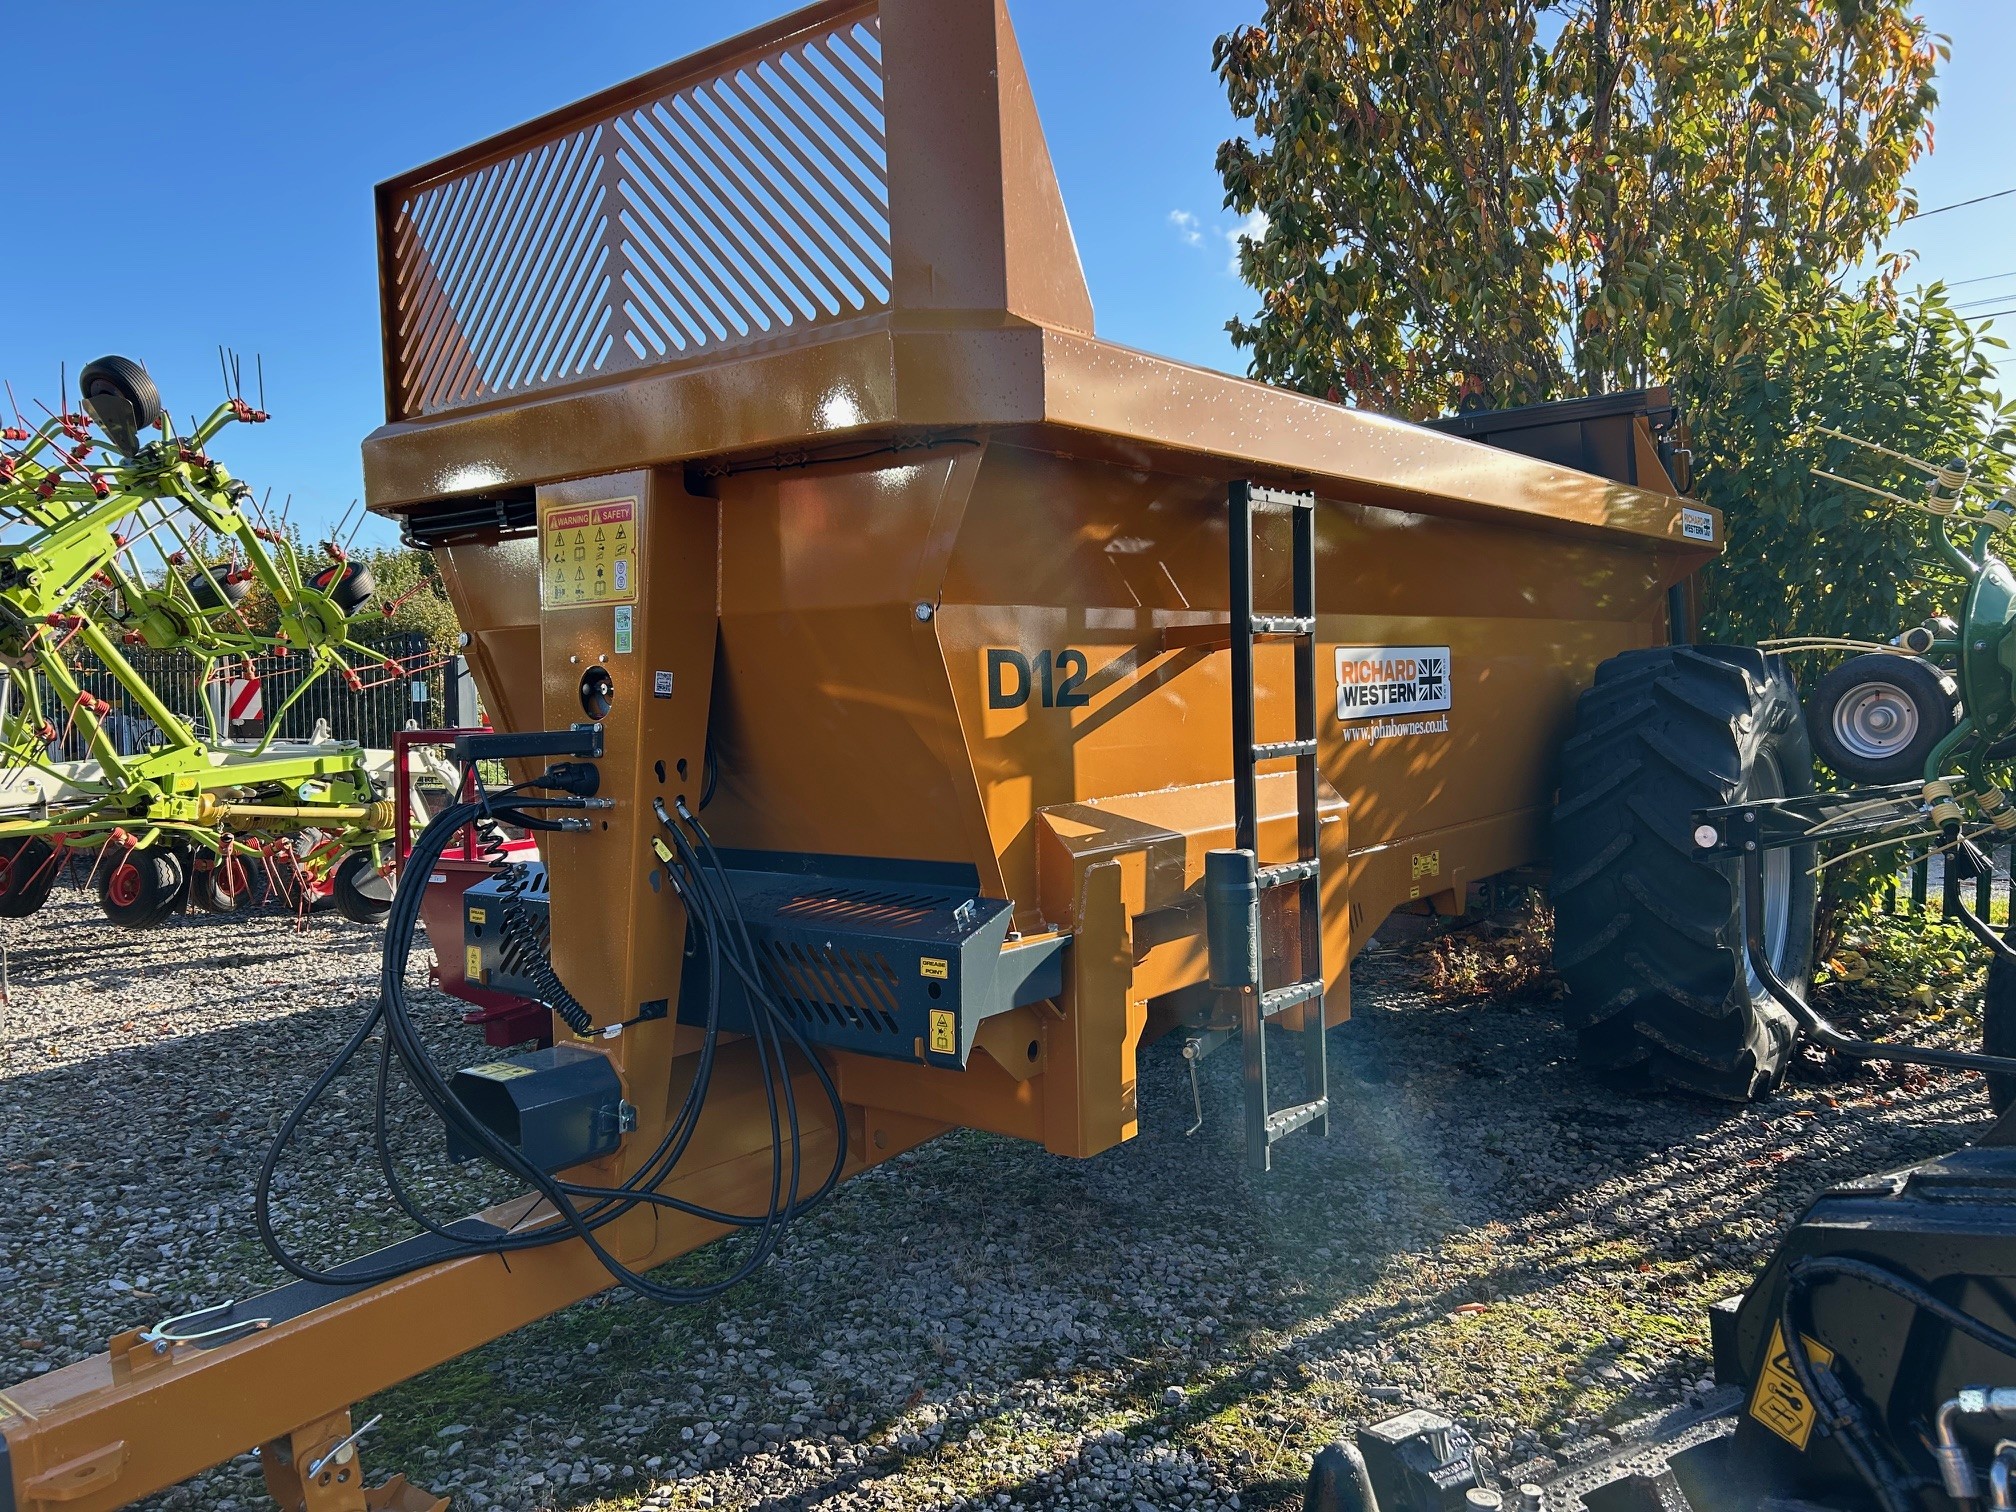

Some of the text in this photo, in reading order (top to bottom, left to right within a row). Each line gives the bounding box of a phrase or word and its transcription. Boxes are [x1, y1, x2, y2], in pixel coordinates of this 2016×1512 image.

[558, 509, 630, 526] WARNING SAFETY
[987, 649, 1090, 709] D12
[1341, 659, 1417, 684] RICHARD
[1343, 683, 1417, 707] WESTERN
[1342, 714, 1449, 746] www.johnbownes.co.uk
